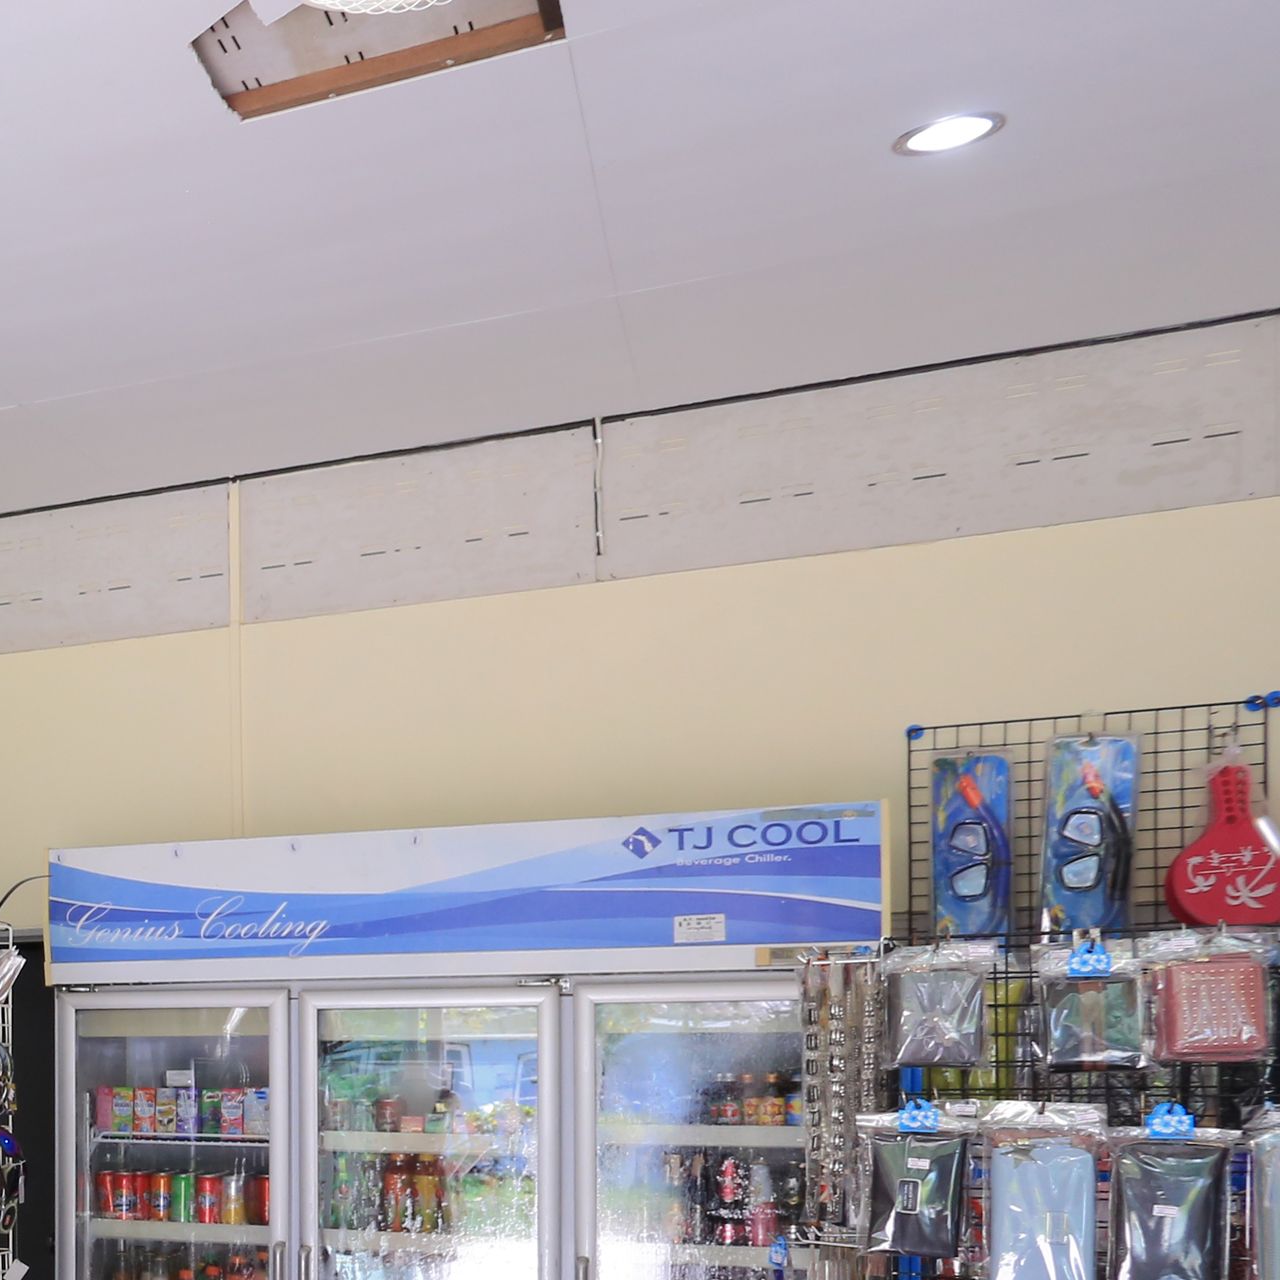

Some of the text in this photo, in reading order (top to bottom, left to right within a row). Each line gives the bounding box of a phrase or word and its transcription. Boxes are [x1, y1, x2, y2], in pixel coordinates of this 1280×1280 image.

[668, 820, 860, 851] TJ COOL
[676, 854, 740, 866] Beverage
[66, 895, 330, 958] Genius Cooling
